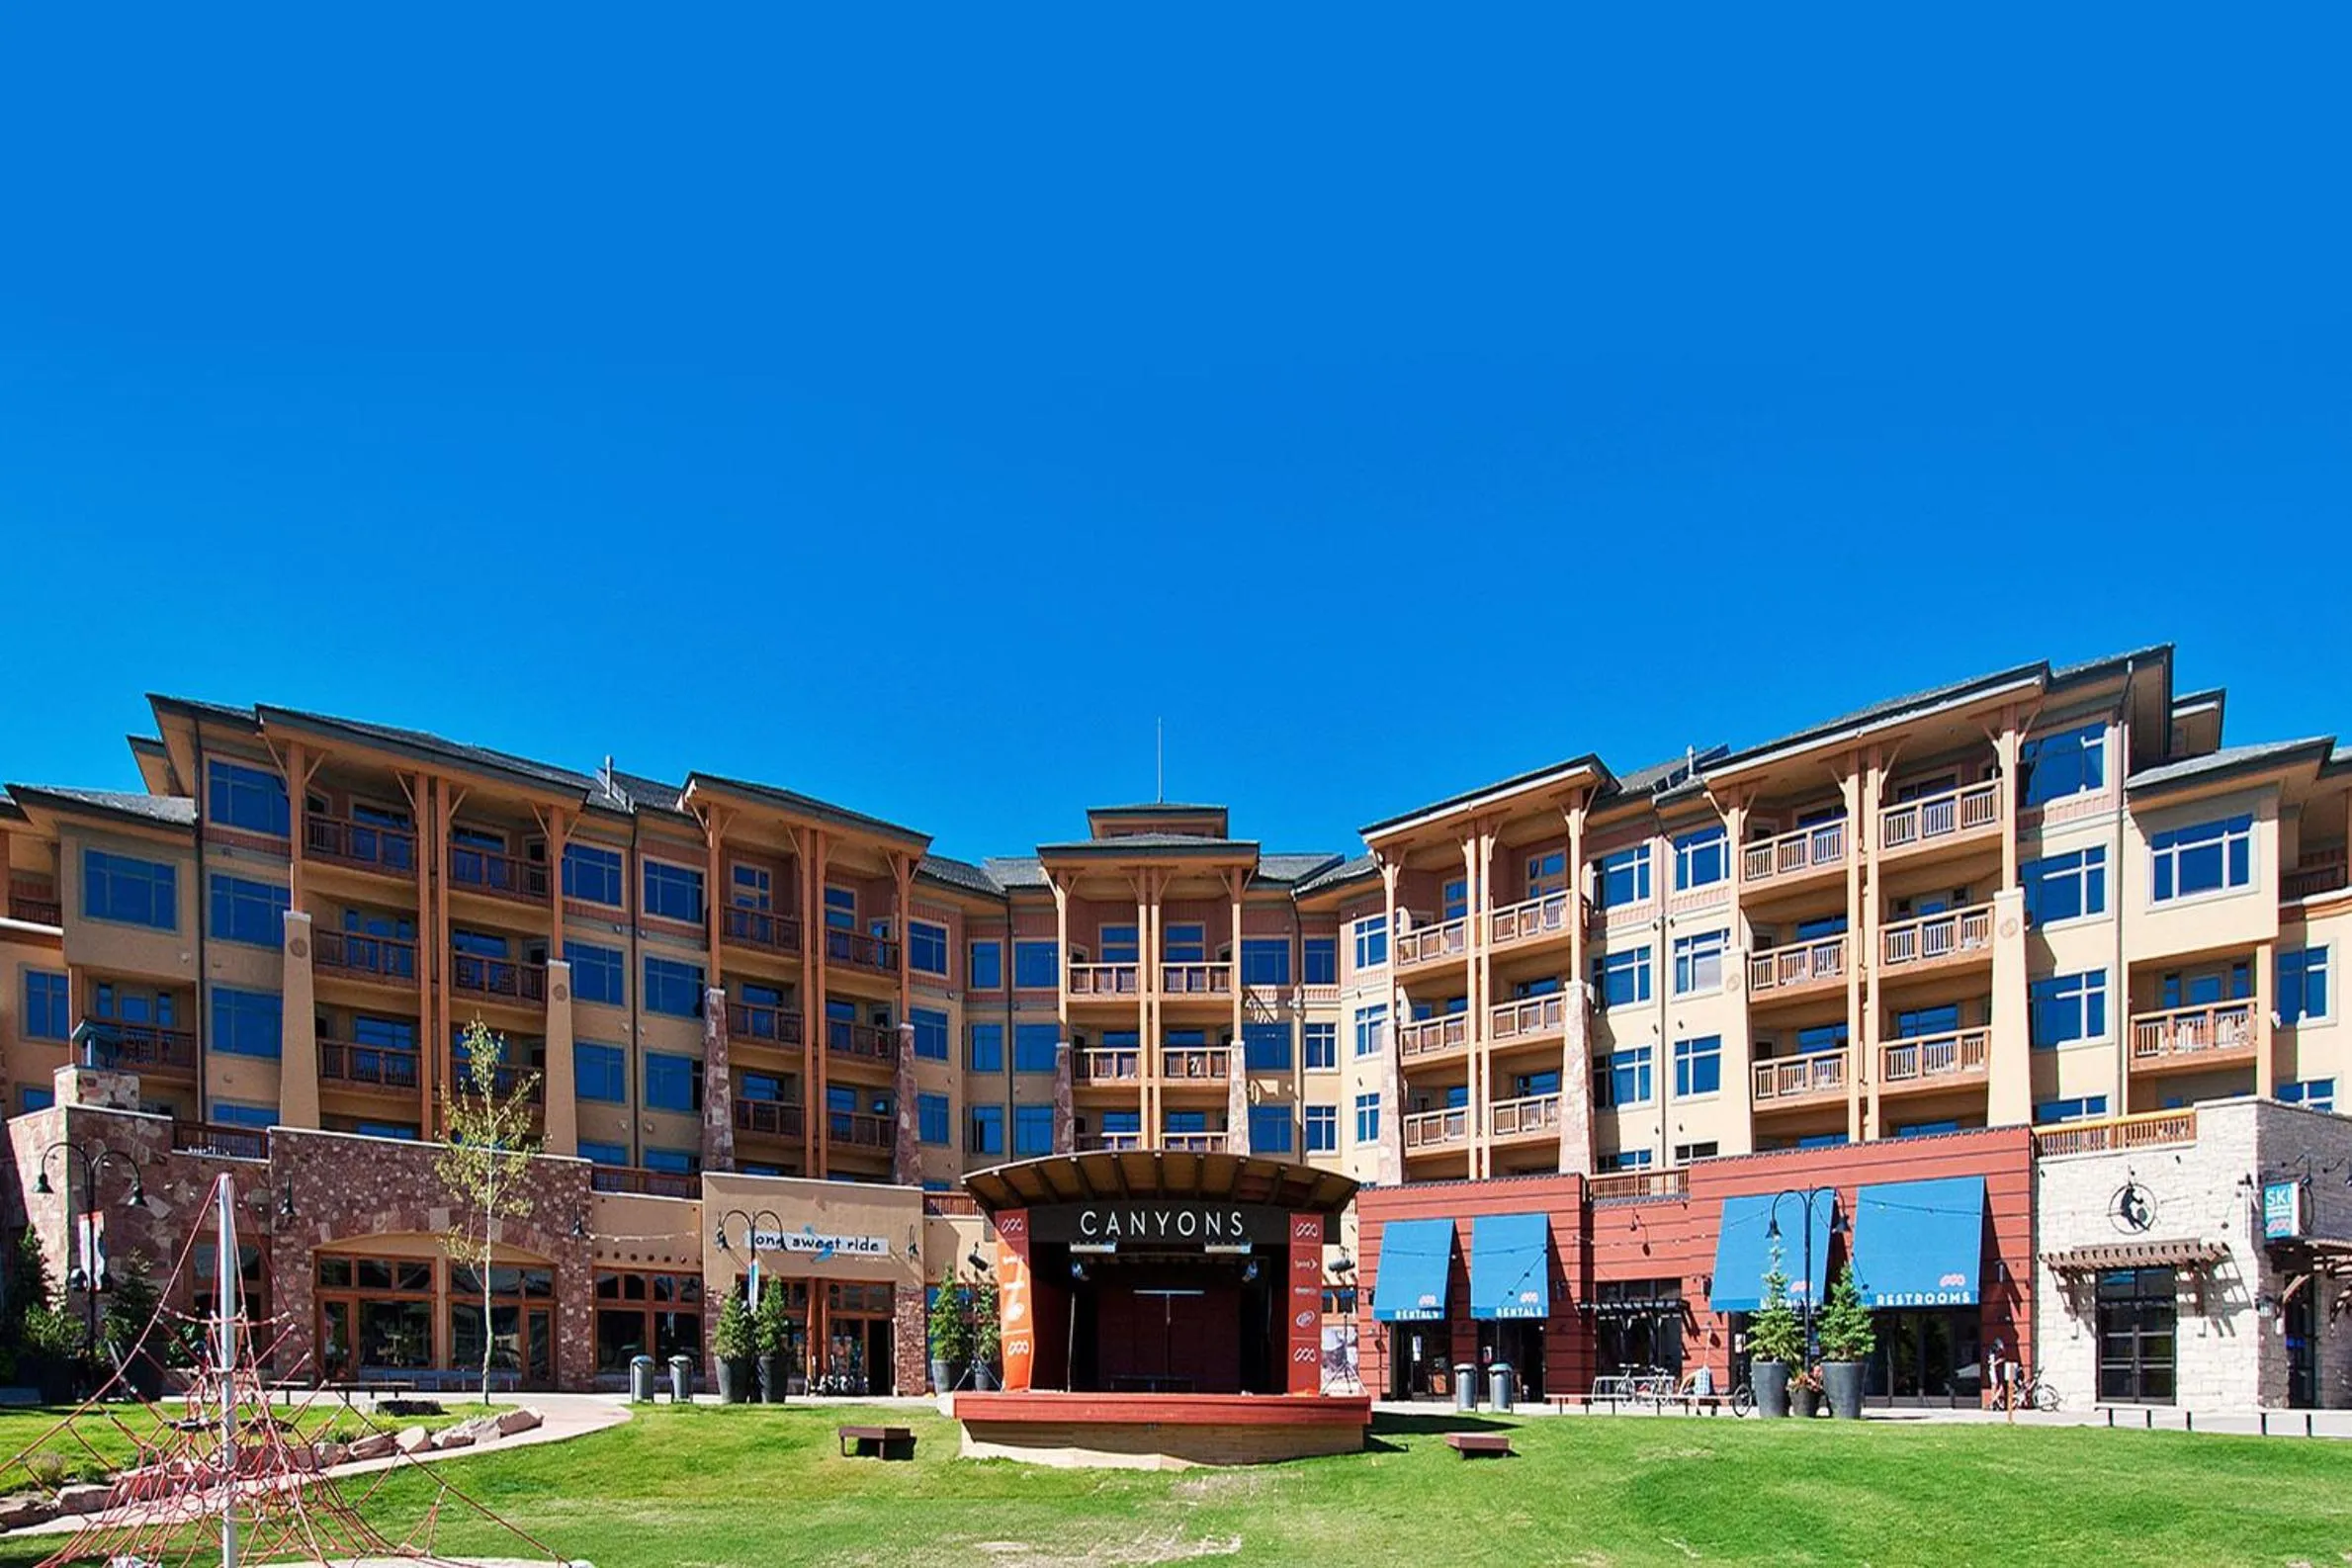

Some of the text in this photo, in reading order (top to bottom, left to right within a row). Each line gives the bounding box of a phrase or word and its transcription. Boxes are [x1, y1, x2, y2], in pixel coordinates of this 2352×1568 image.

[2266, 1188, 2292, 1206] SKI
[1080, 1210, 1244, 1237] CANYONS
[792, 1236, 840, 1250] sweet
[847, 1237, 879, 1252] ride
[1875, 1291, 1970, 1306] RESTROOMS
[1496, 1306, 1543, 1318] RENTALS
